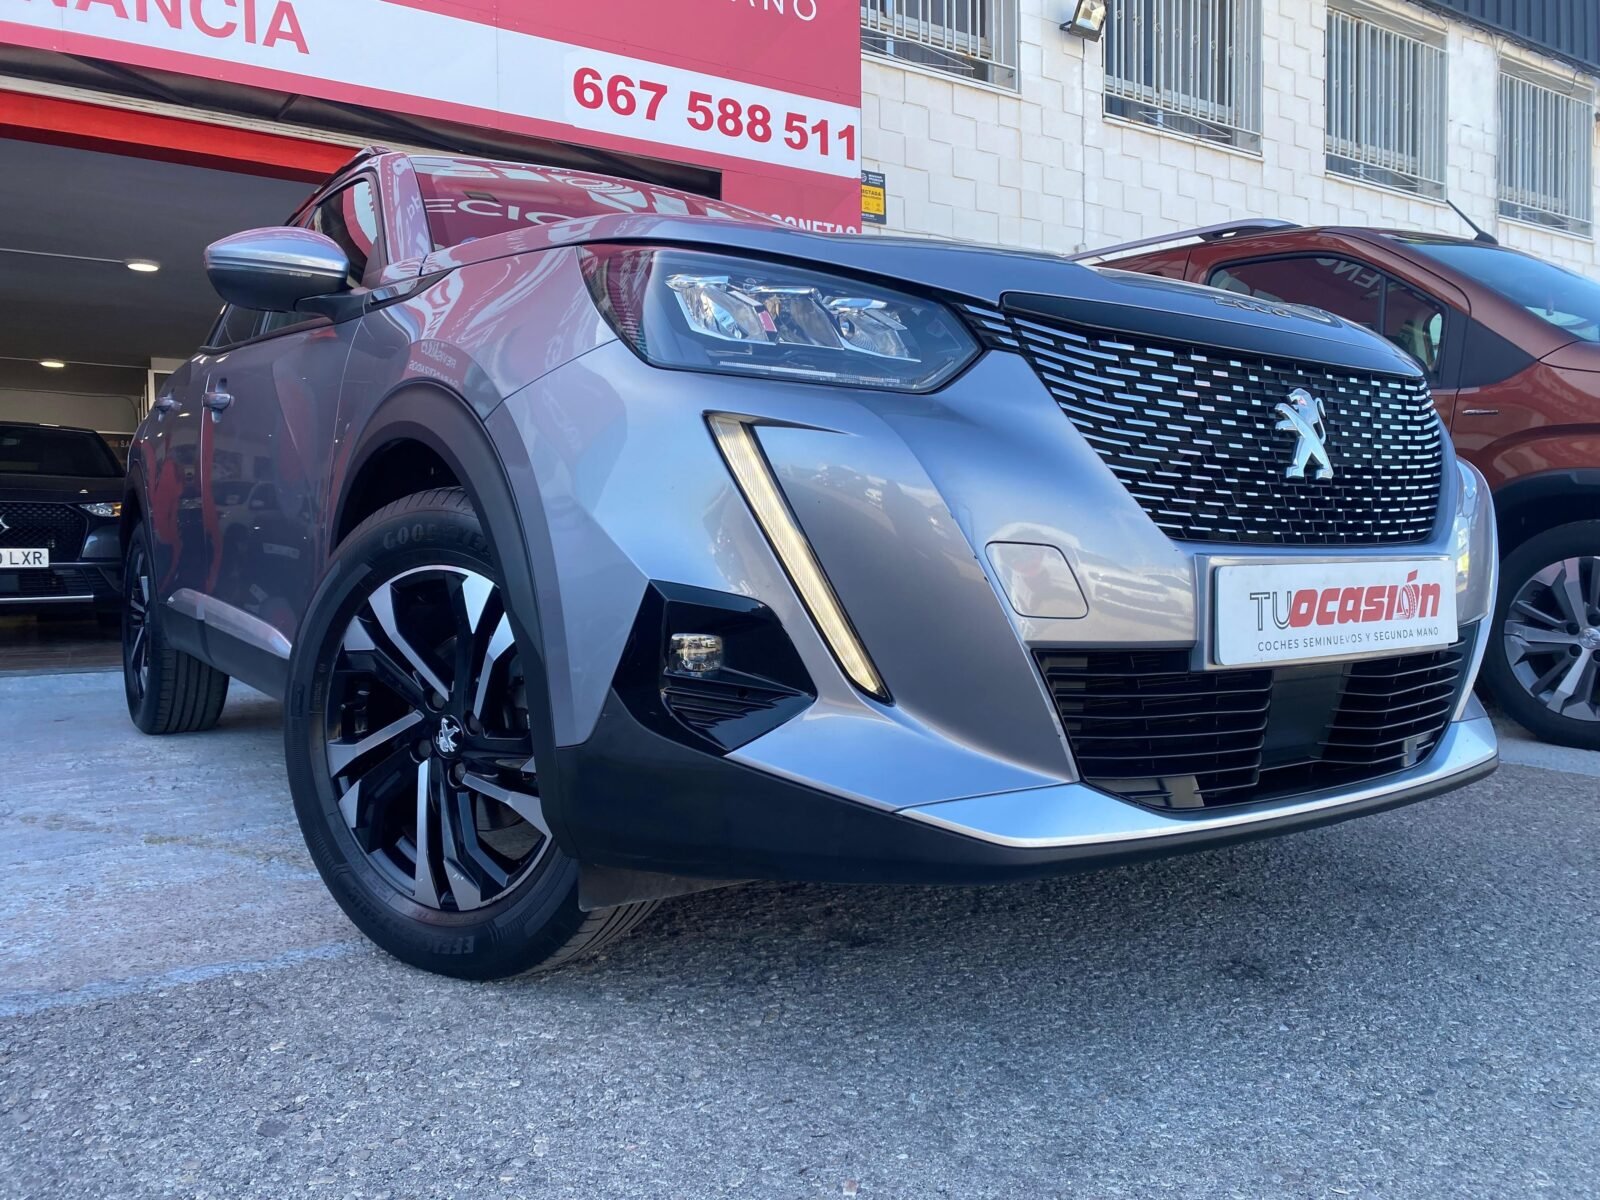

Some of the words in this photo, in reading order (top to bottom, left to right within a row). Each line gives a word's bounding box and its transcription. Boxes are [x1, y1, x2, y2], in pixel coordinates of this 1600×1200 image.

[26, 0, 310, 55] NCIA
[573, 67, 668, 121] 667
[687, 91, 772, 143] 588
[784, 112, 856, 161] 511
[9, 551, 43, 565] LXR
[1258, 638, 1299, 652] COCHES
[1303, 634, 1363, 650] SEMINUEVOS
[1365, 632, 1371, 642] Y
[1374, 629, 1414, 642] SEGUNDA
[1416, 626, 1439, 638] MANO
